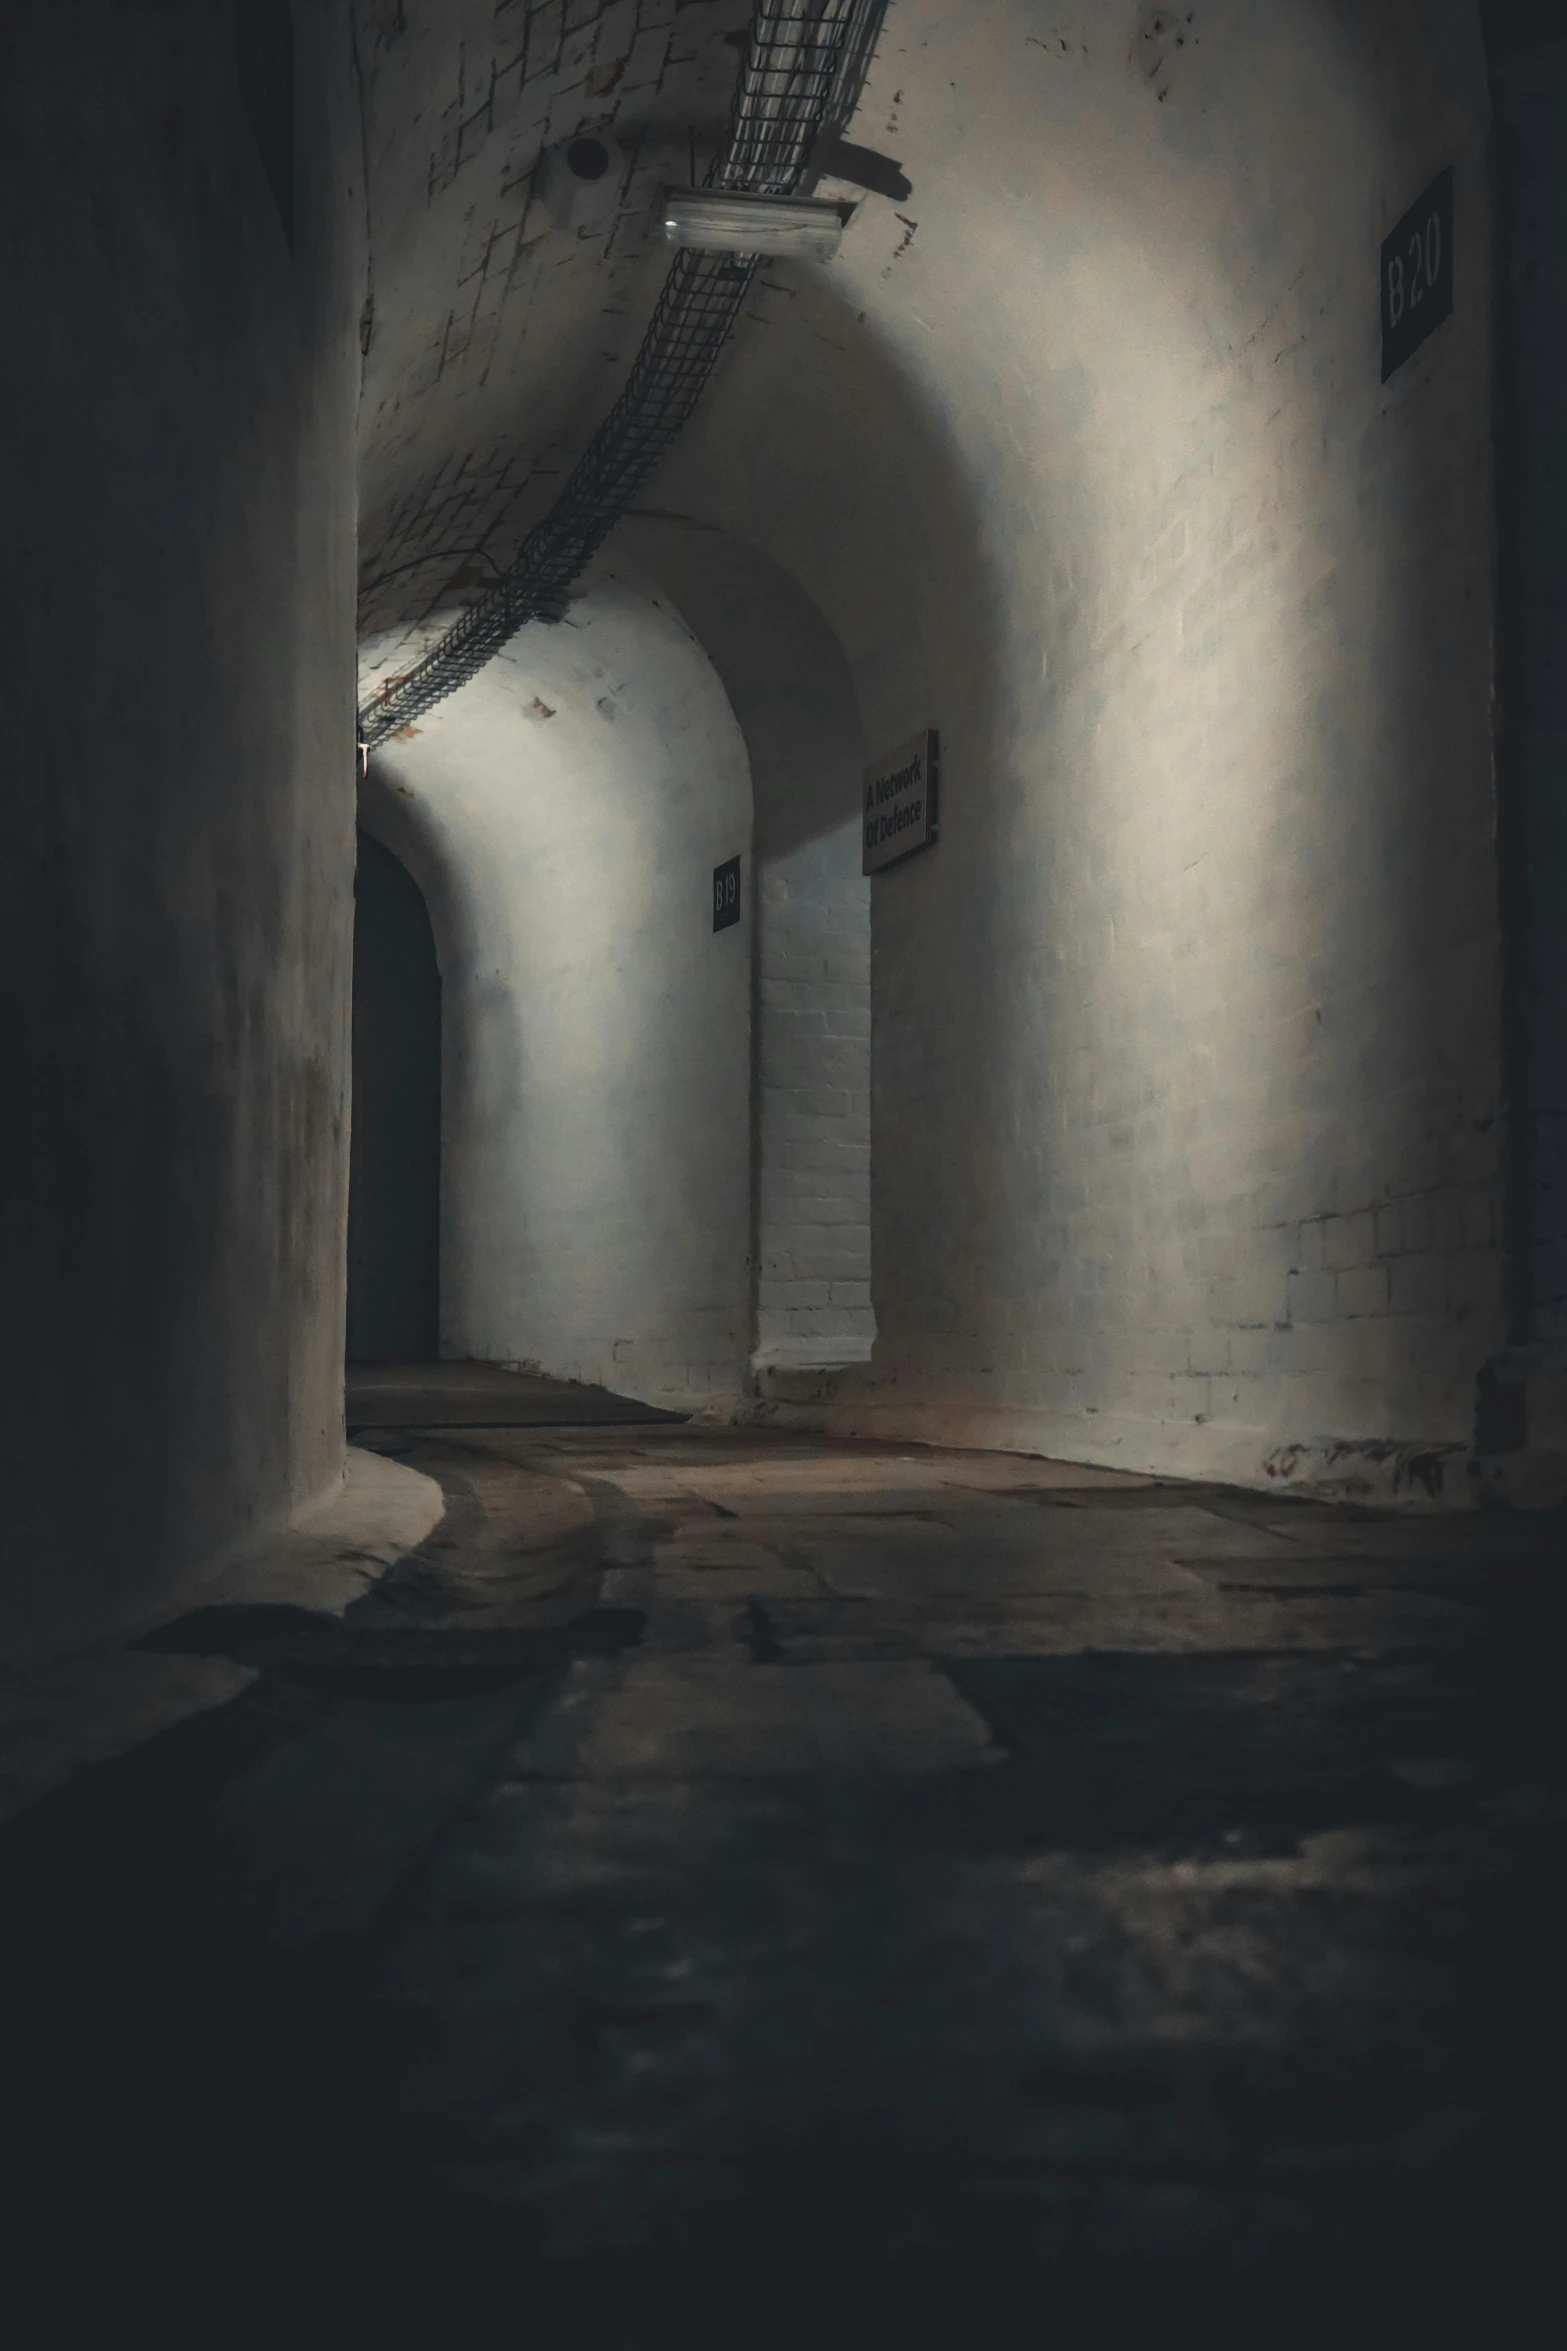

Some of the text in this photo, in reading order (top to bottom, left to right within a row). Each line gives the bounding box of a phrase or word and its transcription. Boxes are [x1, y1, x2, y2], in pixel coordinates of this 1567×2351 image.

[866, 753, 921, 812] A Network
[866, 799, 921, 848] Of Defence
